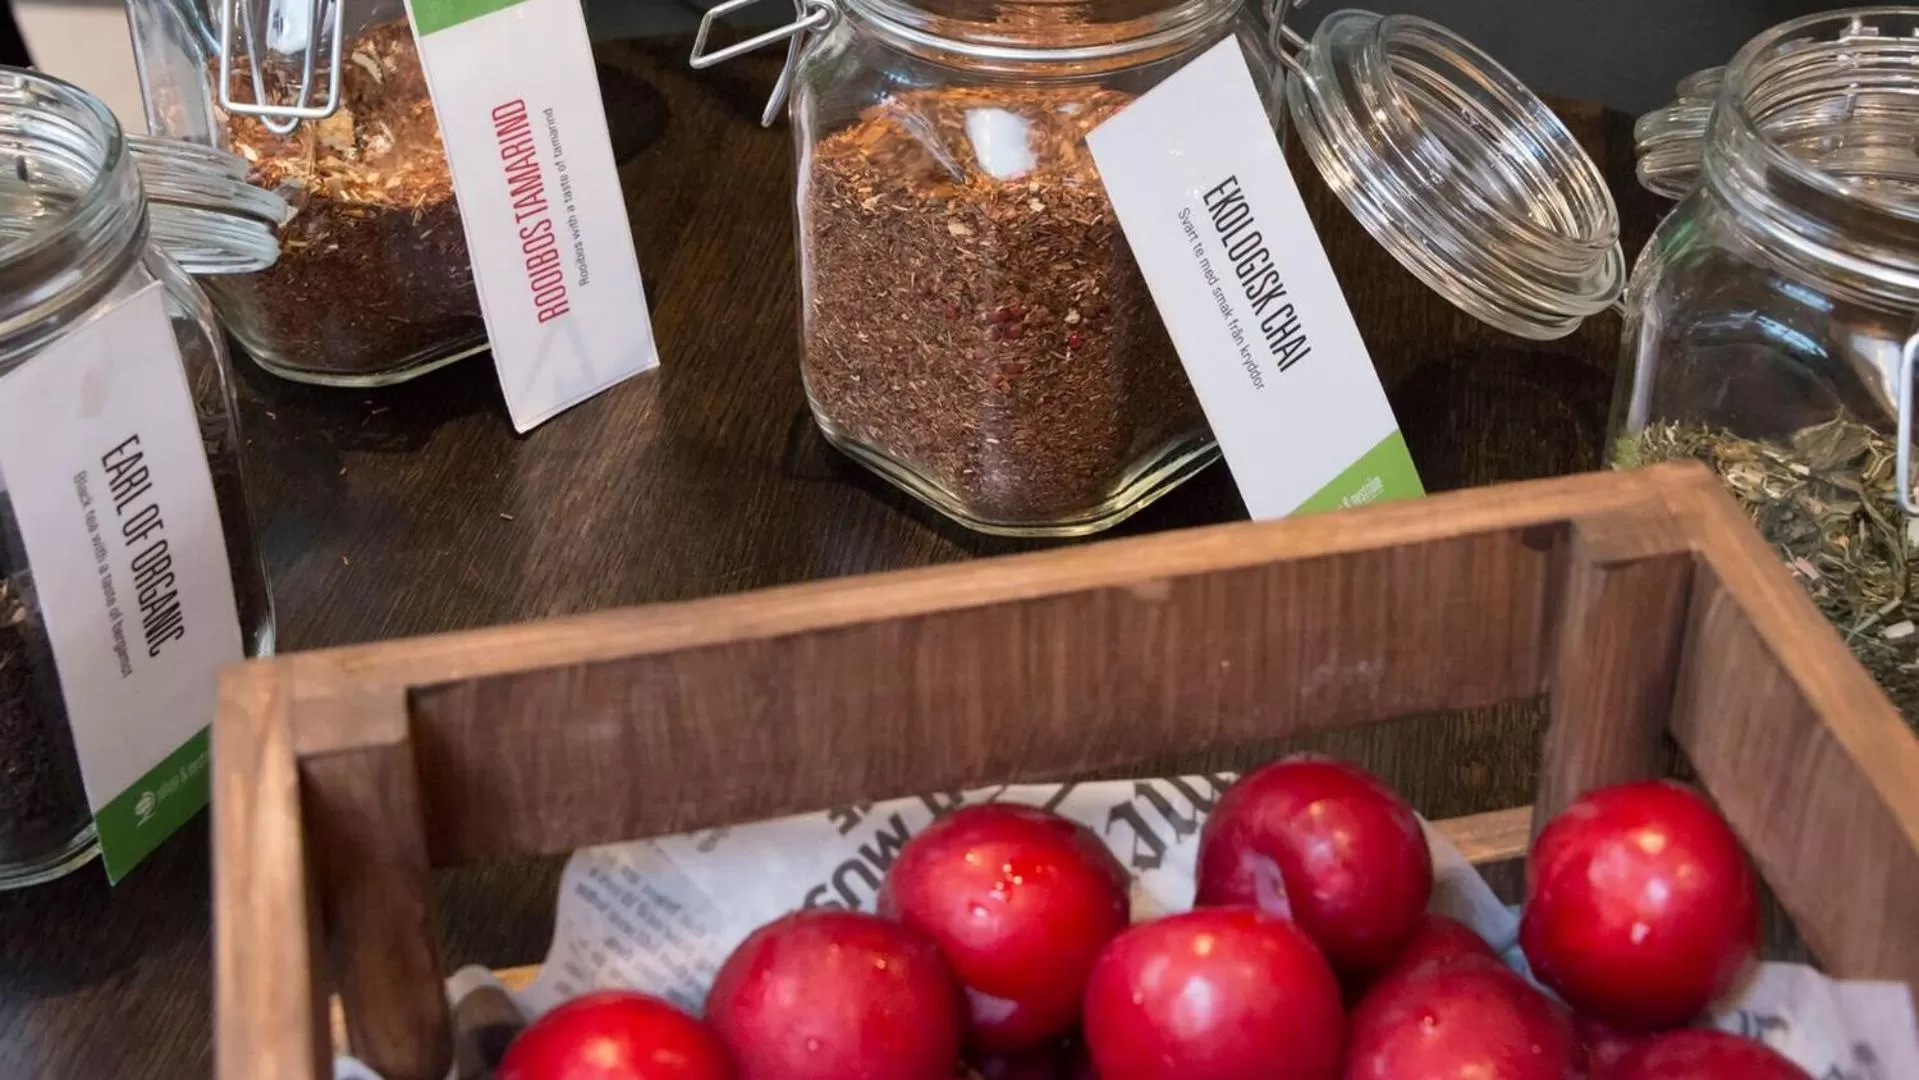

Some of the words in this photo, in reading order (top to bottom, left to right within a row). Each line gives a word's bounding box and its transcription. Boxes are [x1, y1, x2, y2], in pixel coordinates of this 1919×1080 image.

[542, 107, 563, 160] tamarind
[491, 98, 549, 225] TAMARIND
[554, 160, 567, 173] of
[559, 171, 574, 204] taste
[566, 204, 576, 214] a
[567, 214, 581, 240] with
[519, 218, 571, 324] ROOIBOS
[574, 241, 591, 287] Rooibos
[1202, 174, 1288, 317] EKOLOGISK
[1260, 302, 1312, 373] CHAI
[1178, 206, 1199, 243] Svart
[1193, 241, 1205, 258] te
[1199, 257, 1220, 287] med
[1212, 286, 1234, 320] smak
[1228, 318, 1246, 346] från
[1239, 342, 1266, 391] kryddor
[73, 469, 94, 507] Black
[101, 433, 153, 516] EARL
[85, 508, 99, 533] tea
[122, 503, 164, 547] OF
[91, 533, 109, 563] with
[98, 563, 110, 574] a
[101, 573, 117, 608] taste
[130, 539, 186, 658] ORGANIC
[109, 607, 124, 621] of
